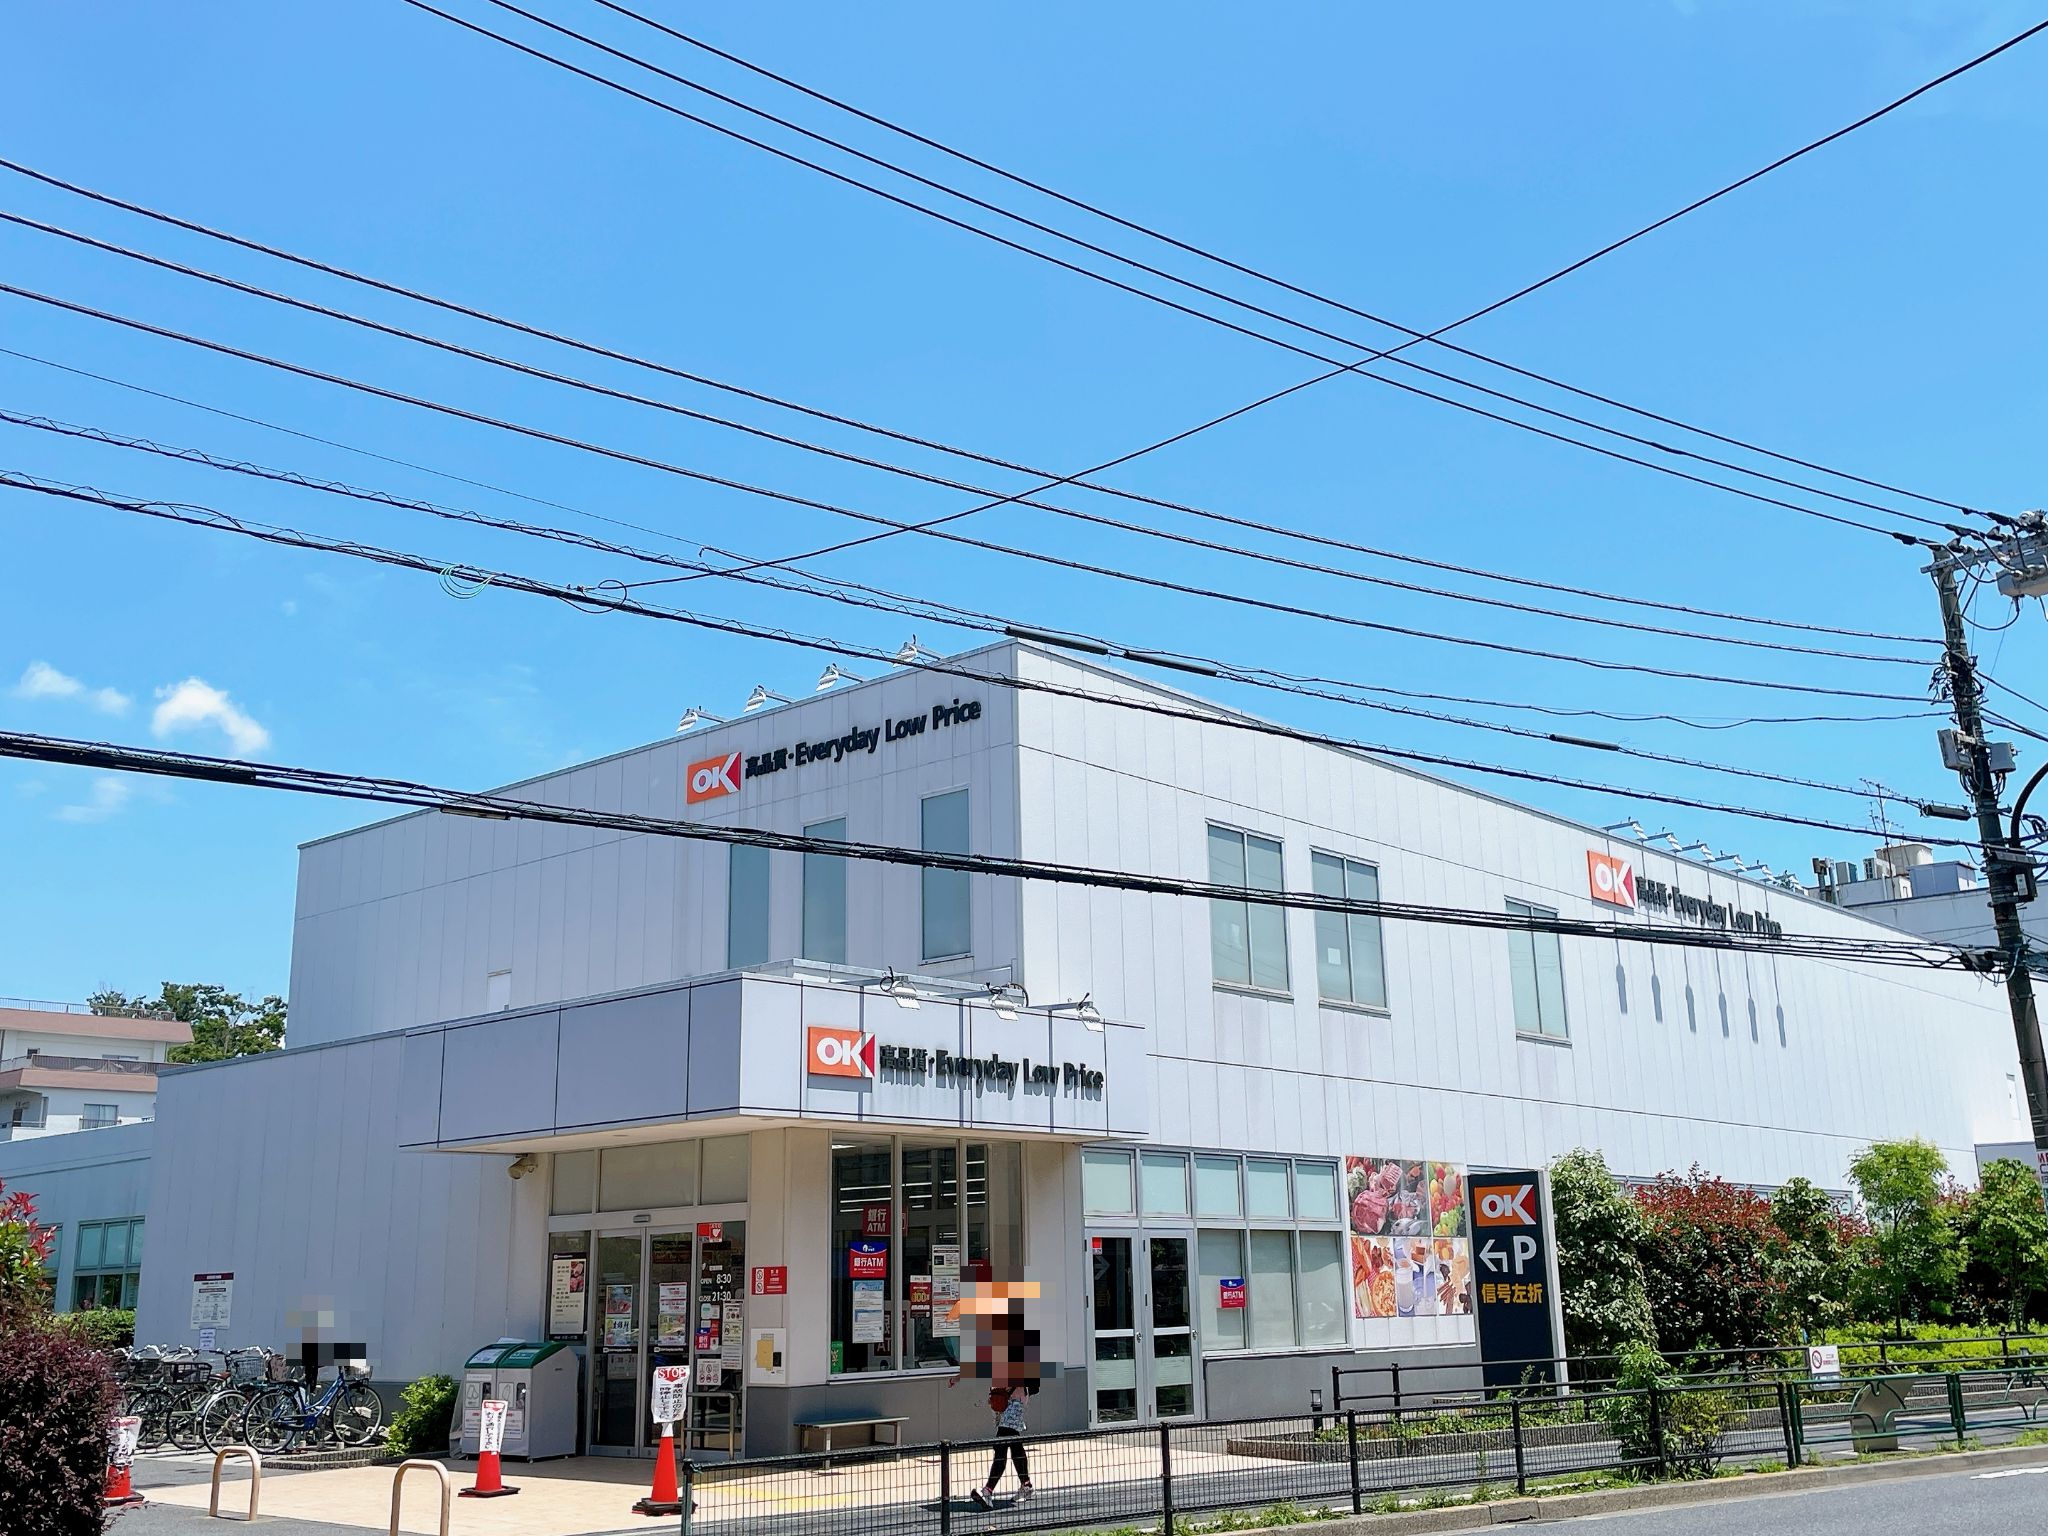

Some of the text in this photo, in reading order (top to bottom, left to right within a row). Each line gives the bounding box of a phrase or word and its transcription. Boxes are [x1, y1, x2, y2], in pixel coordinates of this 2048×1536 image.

[885, 714, 927, 742] Low
[932, 698, 982, 730] Price
[692, 752, 741, 793] OK
[1595, 861, 1636, 908] OK
[816, 1033, 875, 1077] OK
[1023, 1058, 1060, 1083] Low
[1063, 1062, 1105, 1090] Price
[1481, 1185, 1537, 1225] OK
[867, 1222, 886, 1233] ATM
[1512, 1235, 1537, 1275] P
[712, 1291, 732, 1302] 21:30
[716, 1273, 732, 1284] 8:30
[1481, 1283, 1544, 1304] 信号左折
[658, 1367, 687, 1378] STOP
